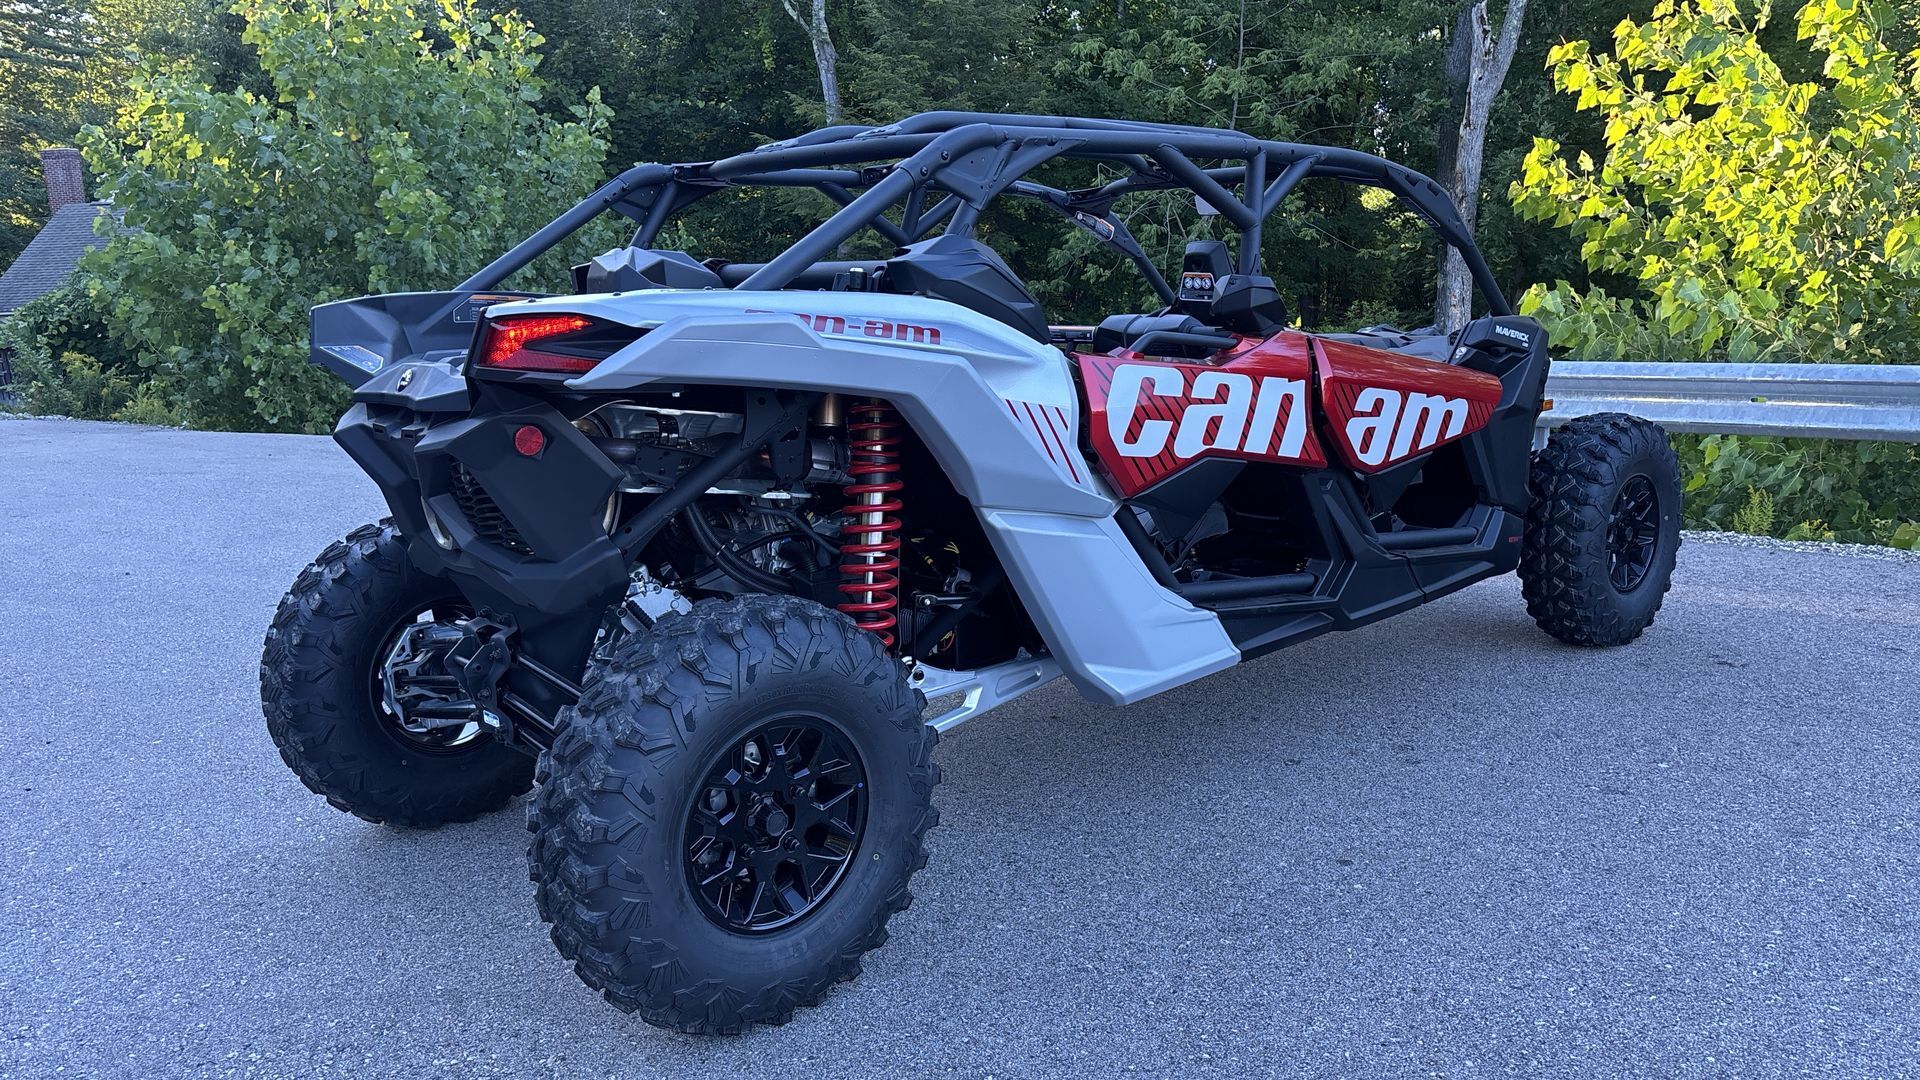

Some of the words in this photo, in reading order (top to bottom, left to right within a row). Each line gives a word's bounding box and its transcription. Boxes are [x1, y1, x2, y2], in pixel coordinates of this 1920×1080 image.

[744, 308, 941, 345] n-am
[1495, 325, 1529, 342] MAVERICK
[1106, 364, 1307, 458] can
[1345, 387, 1469, 466] am
